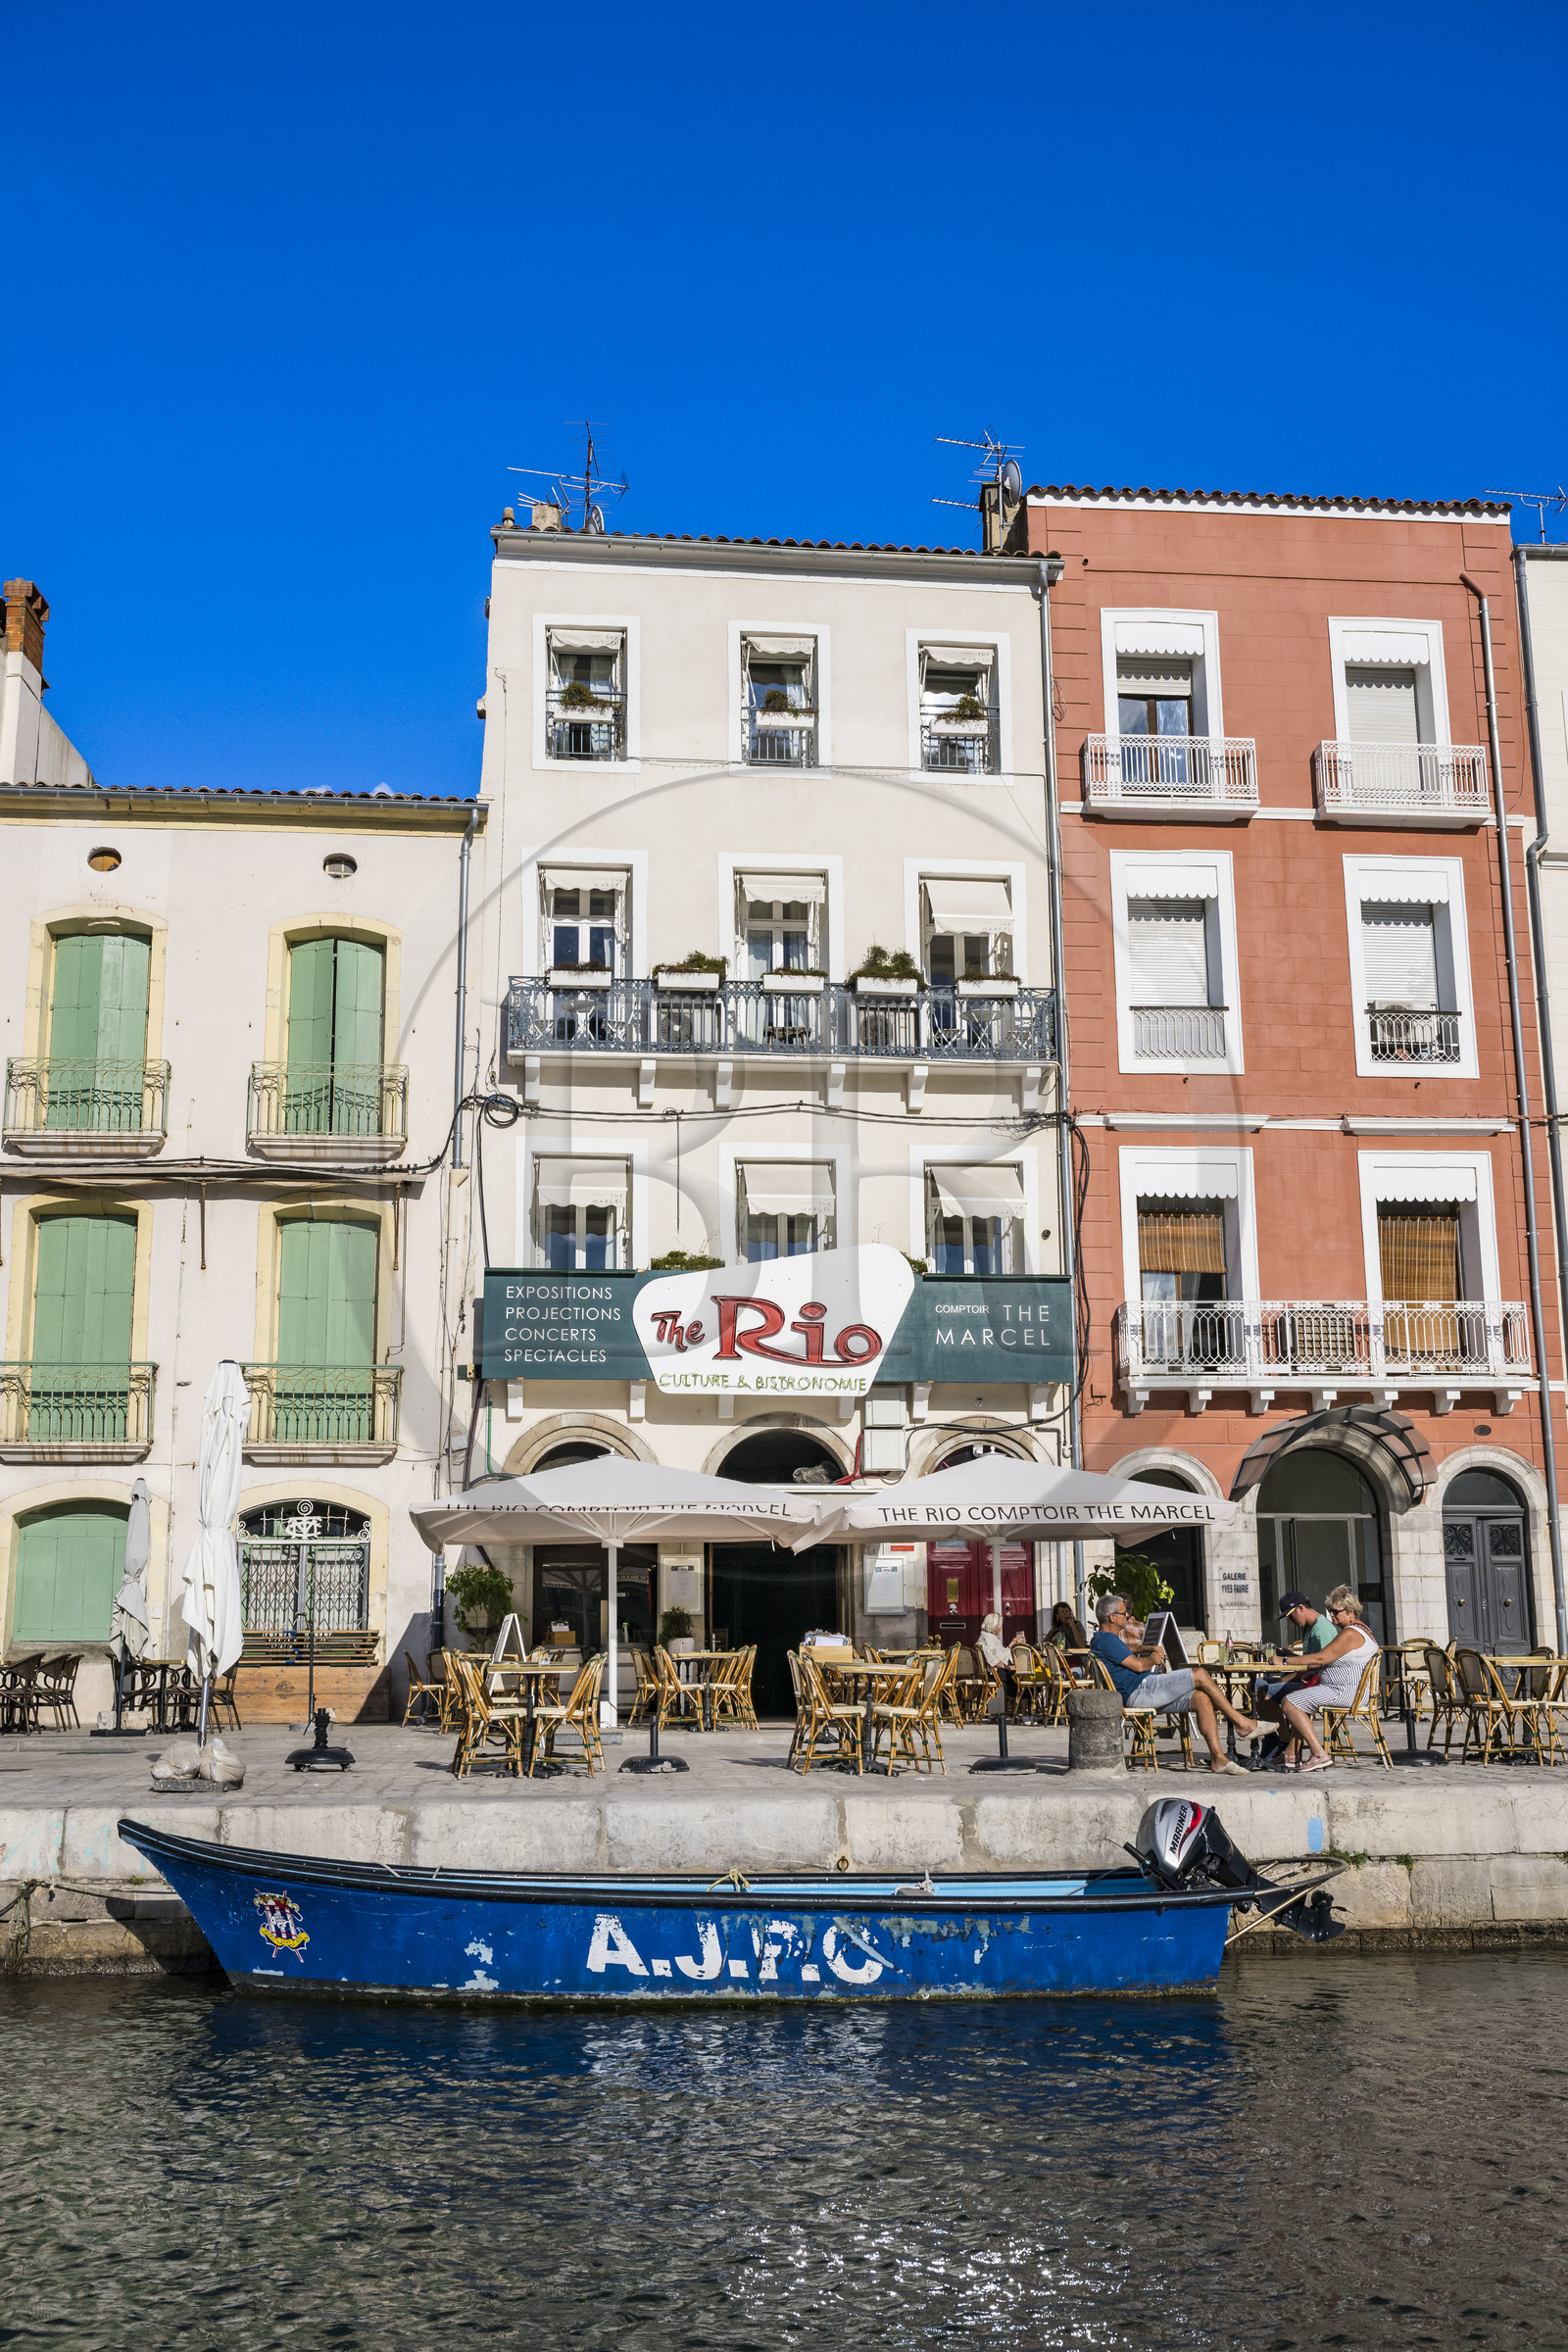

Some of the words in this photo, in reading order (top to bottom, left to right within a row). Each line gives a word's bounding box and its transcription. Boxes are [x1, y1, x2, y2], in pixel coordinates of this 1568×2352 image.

[506, 1286, 612, 1299] EXPOSITIONS
[506, 1306, 621, 1321] PROJECTIONS
[935, 1304, 990, 1314] COMPTOIR
[1003, 1304, 1050, 1322] THE
[505, 1327, 597, 1342] CONCERTS
[651, 1310, 705, 1352] The
[710, 1295, 883, 1369] Rio
[936, 1328, 1051, 1346] MARCEL
[504, 1348, 607, 1363] SPECTACLES
[659, 1373, 730, 1389] CULTURE
[737, 1374, 749, 1388] &
[756, 1376, 867, 1392] BISTRONOMIE
[976, 1397, 983, 1407] 7
[878, 1507, 919, 1522] THE
[925, 1506, 961, 1521] RIO
[967, 1505, 1080, 1521] COMPTOIR
[1084, 1505, 1125, 1519] THE
[1130, 1504, 1216, 1520] MARCEL
[1222, 1572, 1247, 1581] GALERIE
[1169, 1804, 1189, 1857] MARINER
